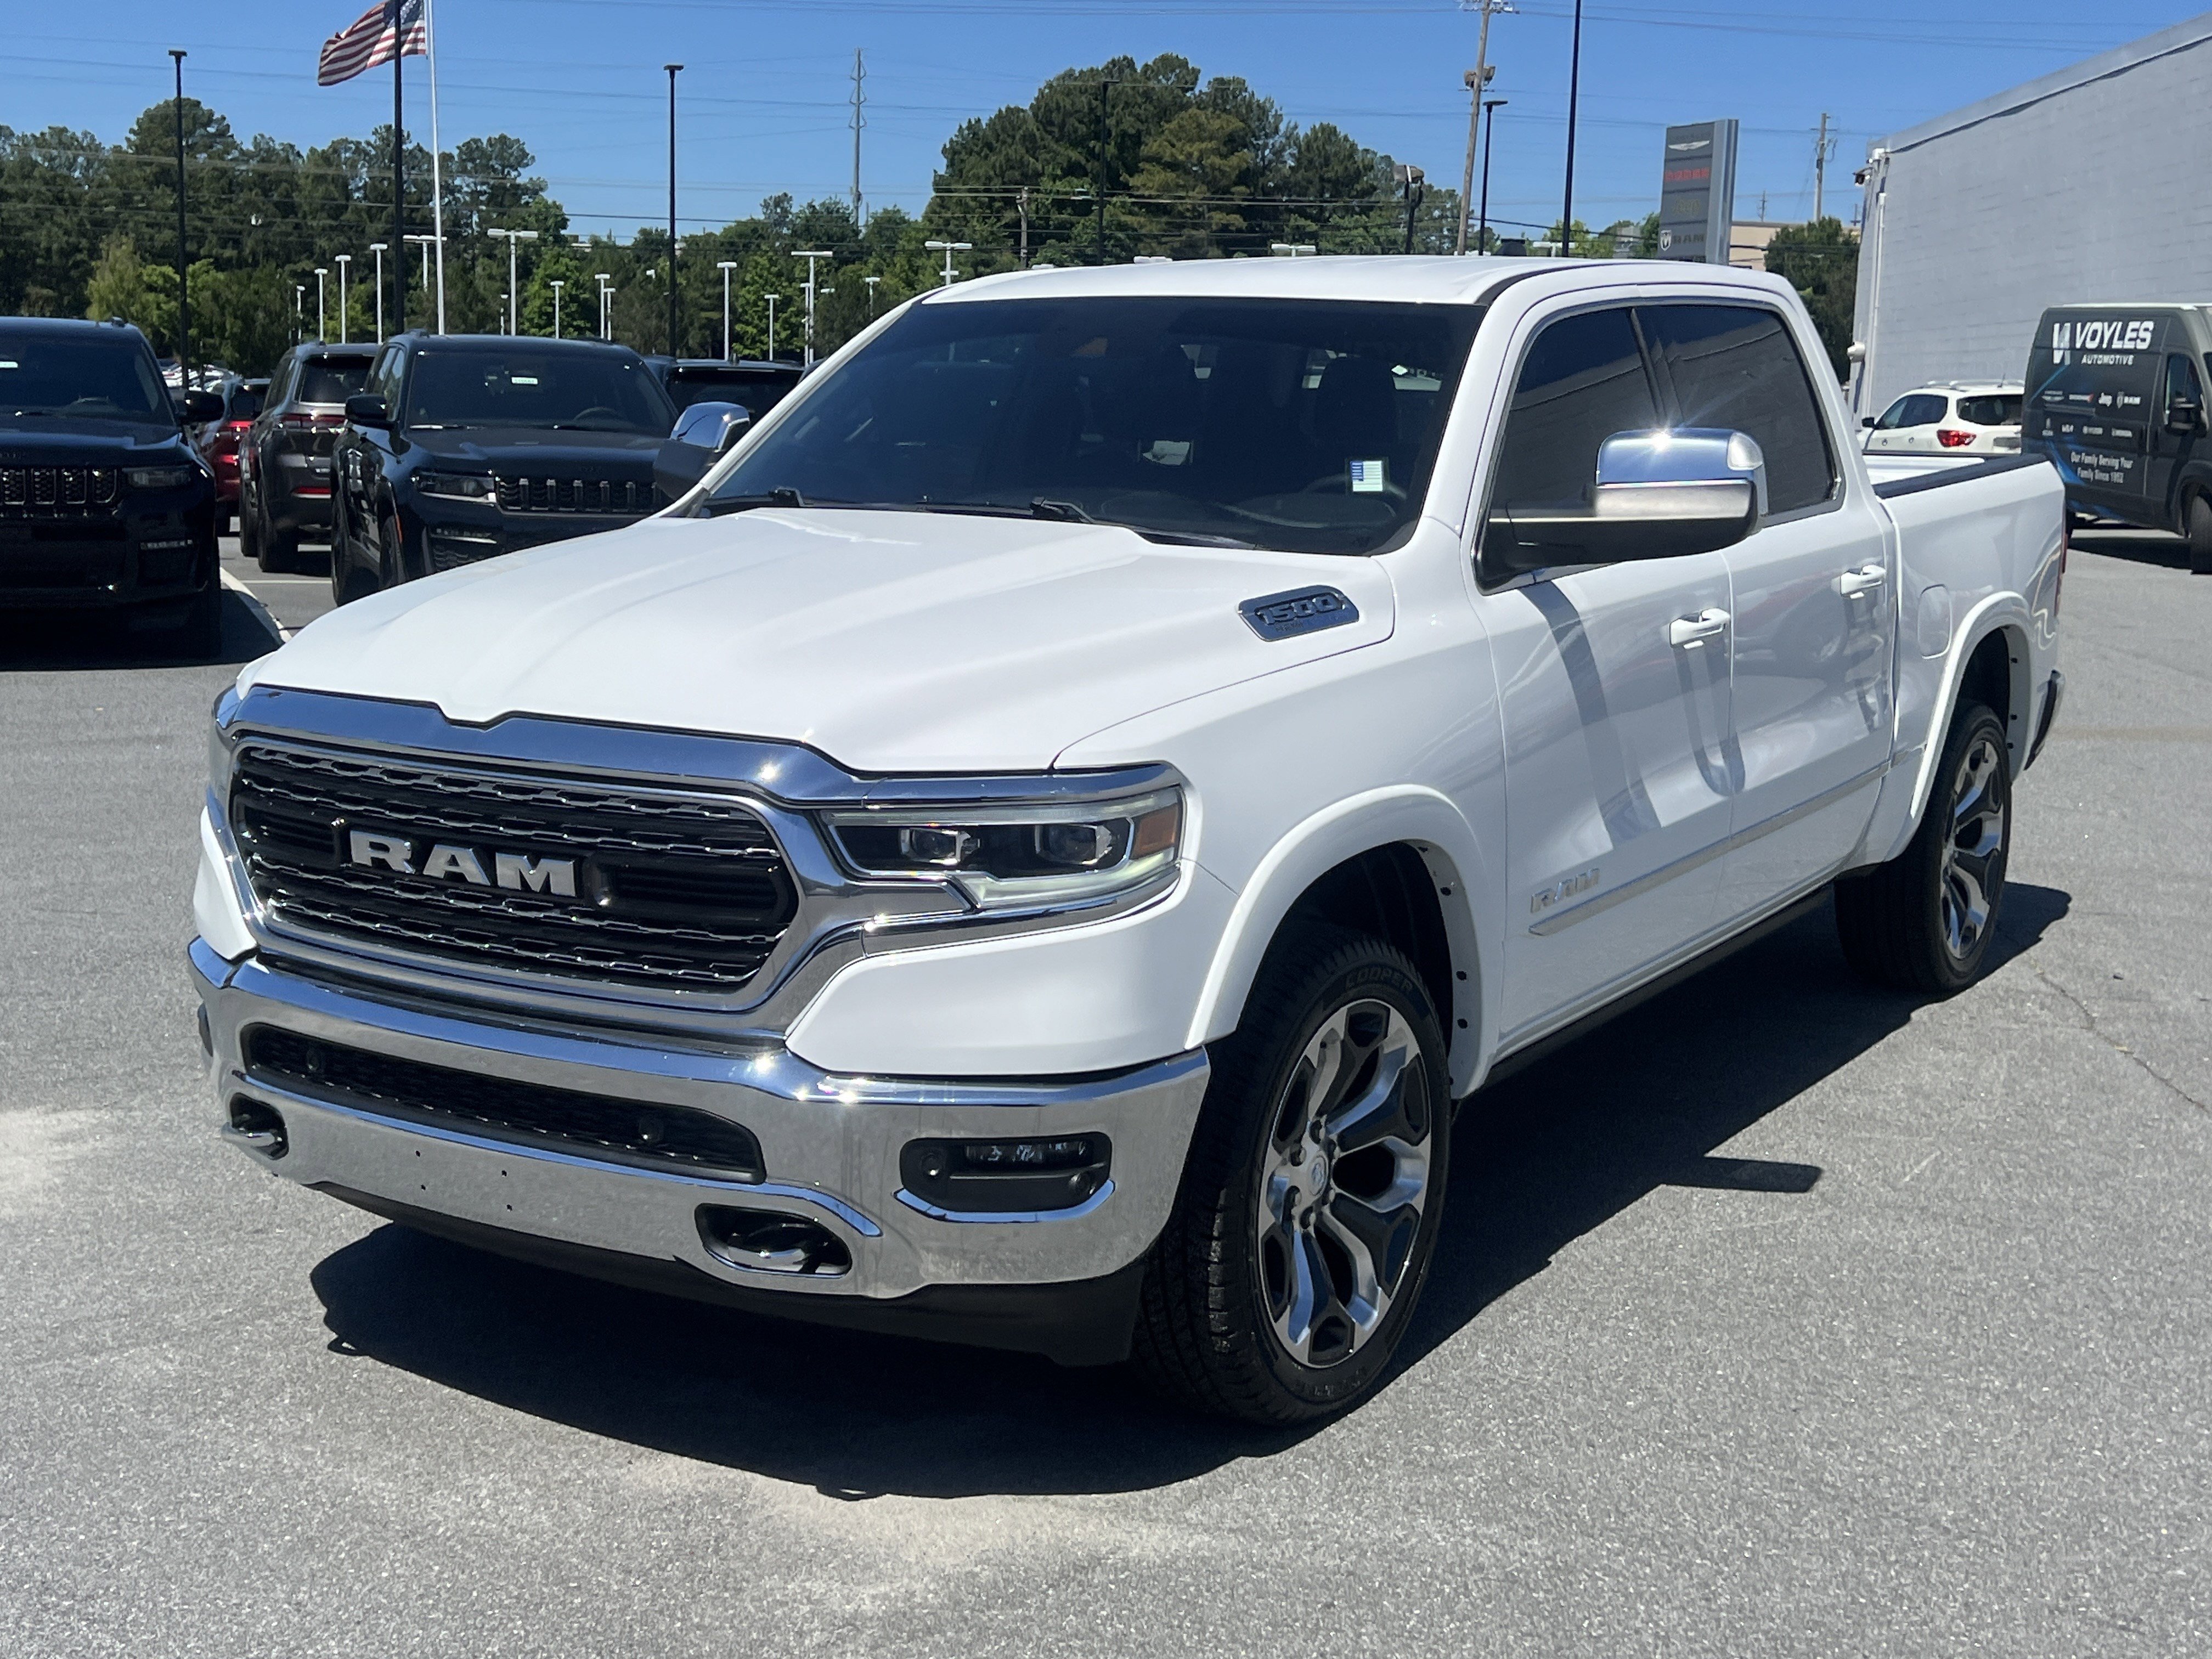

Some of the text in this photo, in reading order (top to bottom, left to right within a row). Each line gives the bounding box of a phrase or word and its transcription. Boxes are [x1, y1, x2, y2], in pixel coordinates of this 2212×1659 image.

[2075, 321, 2154, 349] VOYLES
[2081, 354, 2135, 365] AUTOMOTIVE
[1255, 594, 1338, 625] 1500
[350, 830, 577, 898] RAM
[1531, 868, 1600, 913] RAM
